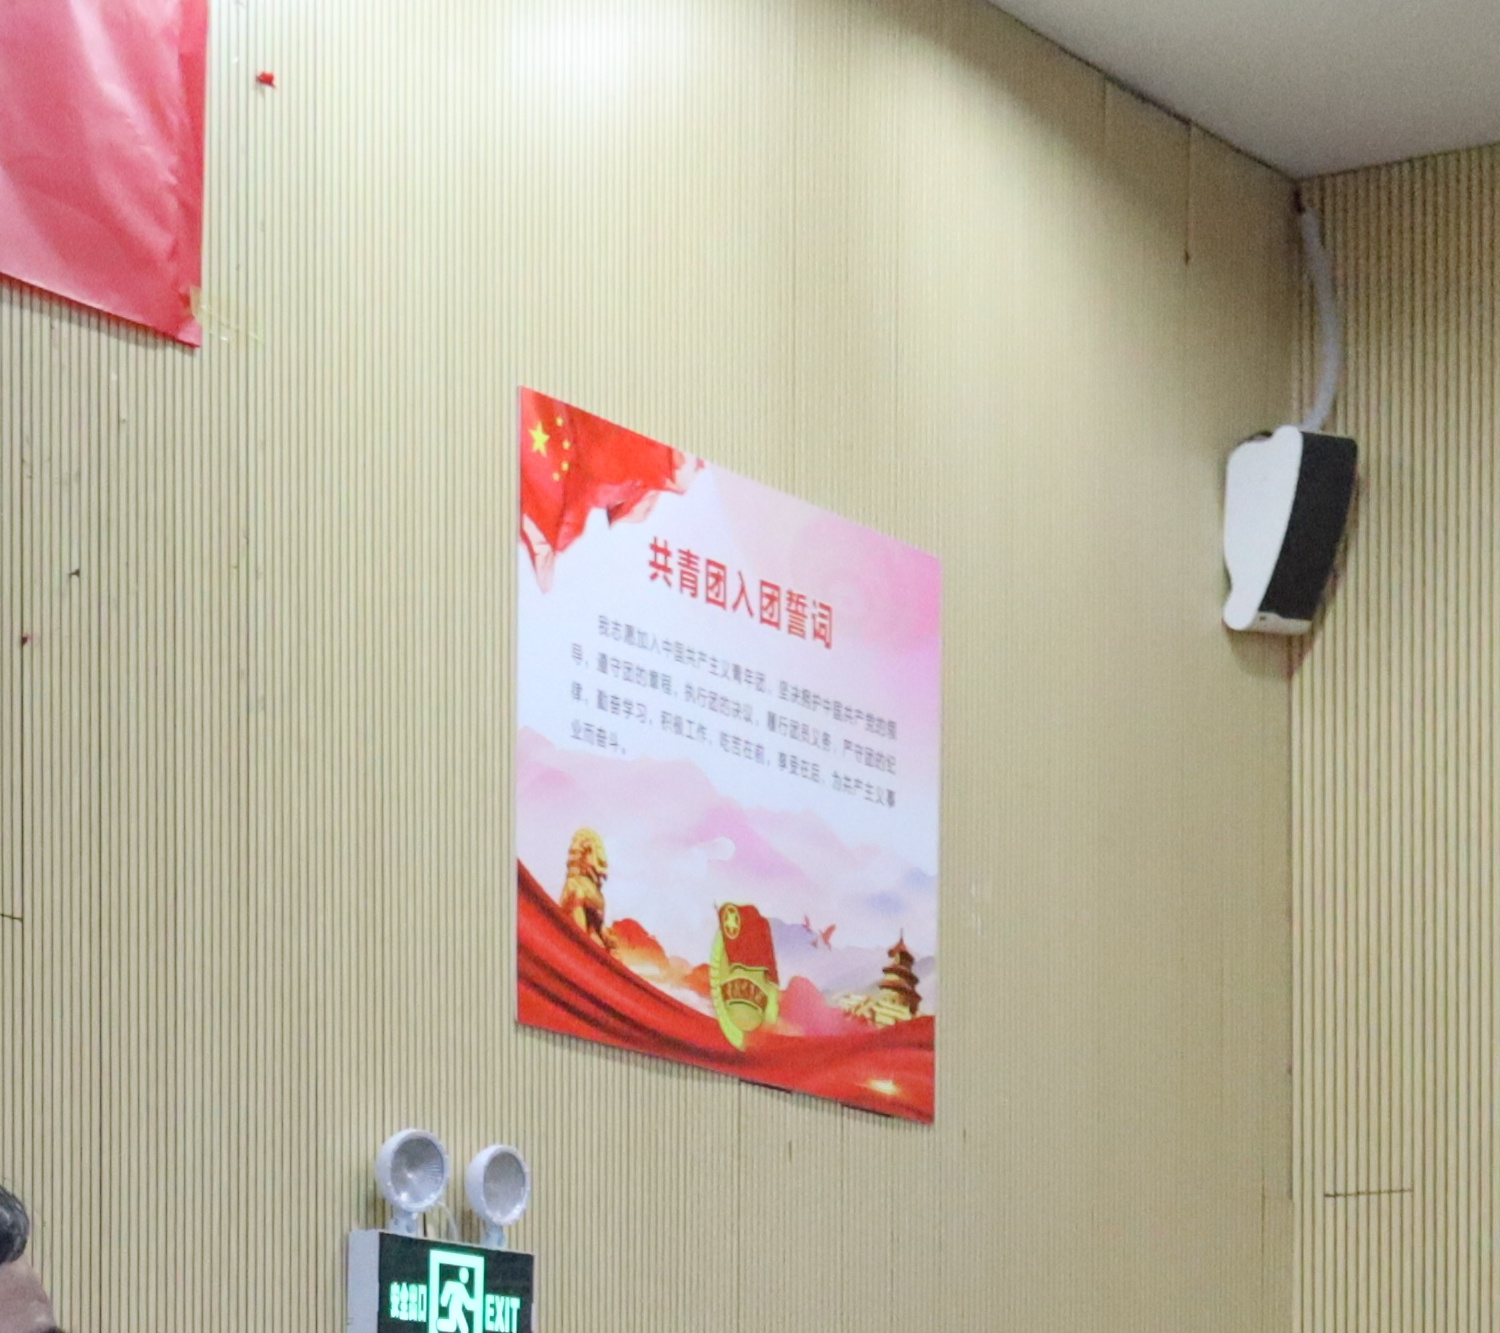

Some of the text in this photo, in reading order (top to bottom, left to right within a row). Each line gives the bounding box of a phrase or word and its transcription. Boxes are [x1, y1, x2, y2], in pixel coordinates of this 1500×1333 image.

[649, 535, 833, 649] 共青团入团誓词
[485, 1293, 521, 1333] EXIT
